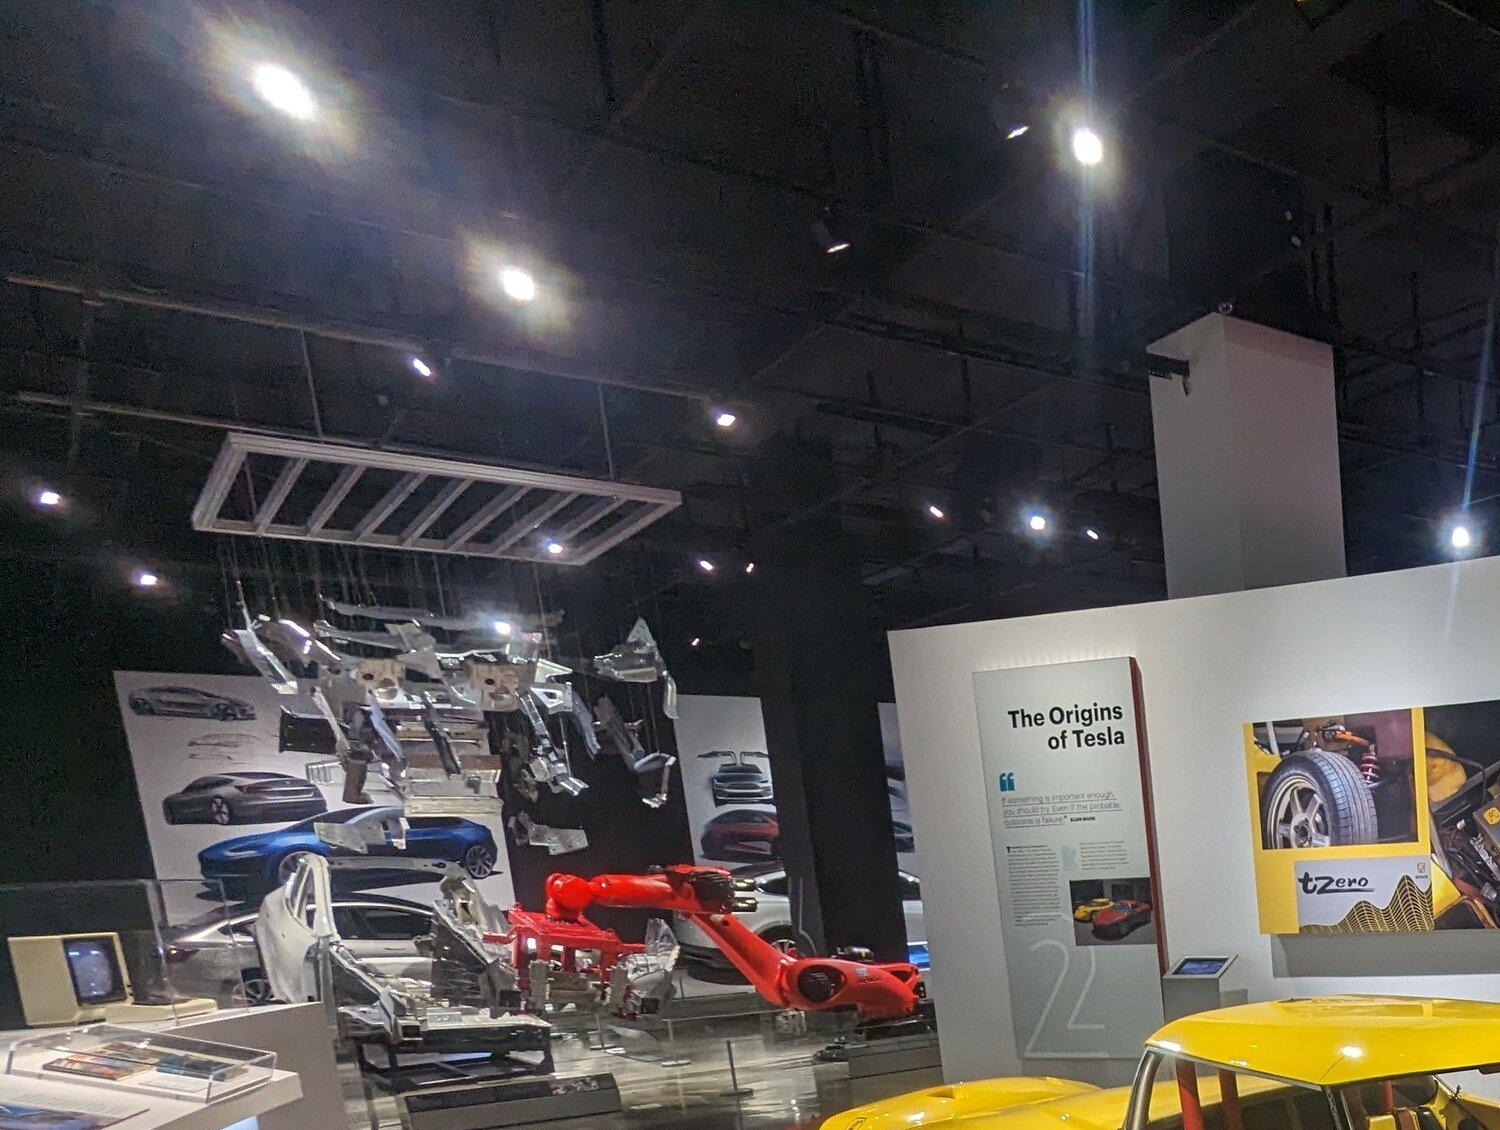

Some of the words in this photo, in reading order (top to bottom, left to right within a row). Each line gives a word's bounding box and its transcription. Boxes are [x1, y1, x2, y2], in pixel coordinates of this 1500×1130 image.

[1007, 708, 1045, 728] The
[1049, 702, 1123, 727] Origins
[1048, 730, 1067, 750] of
[1072, 726, 1125, 748] Tesla
